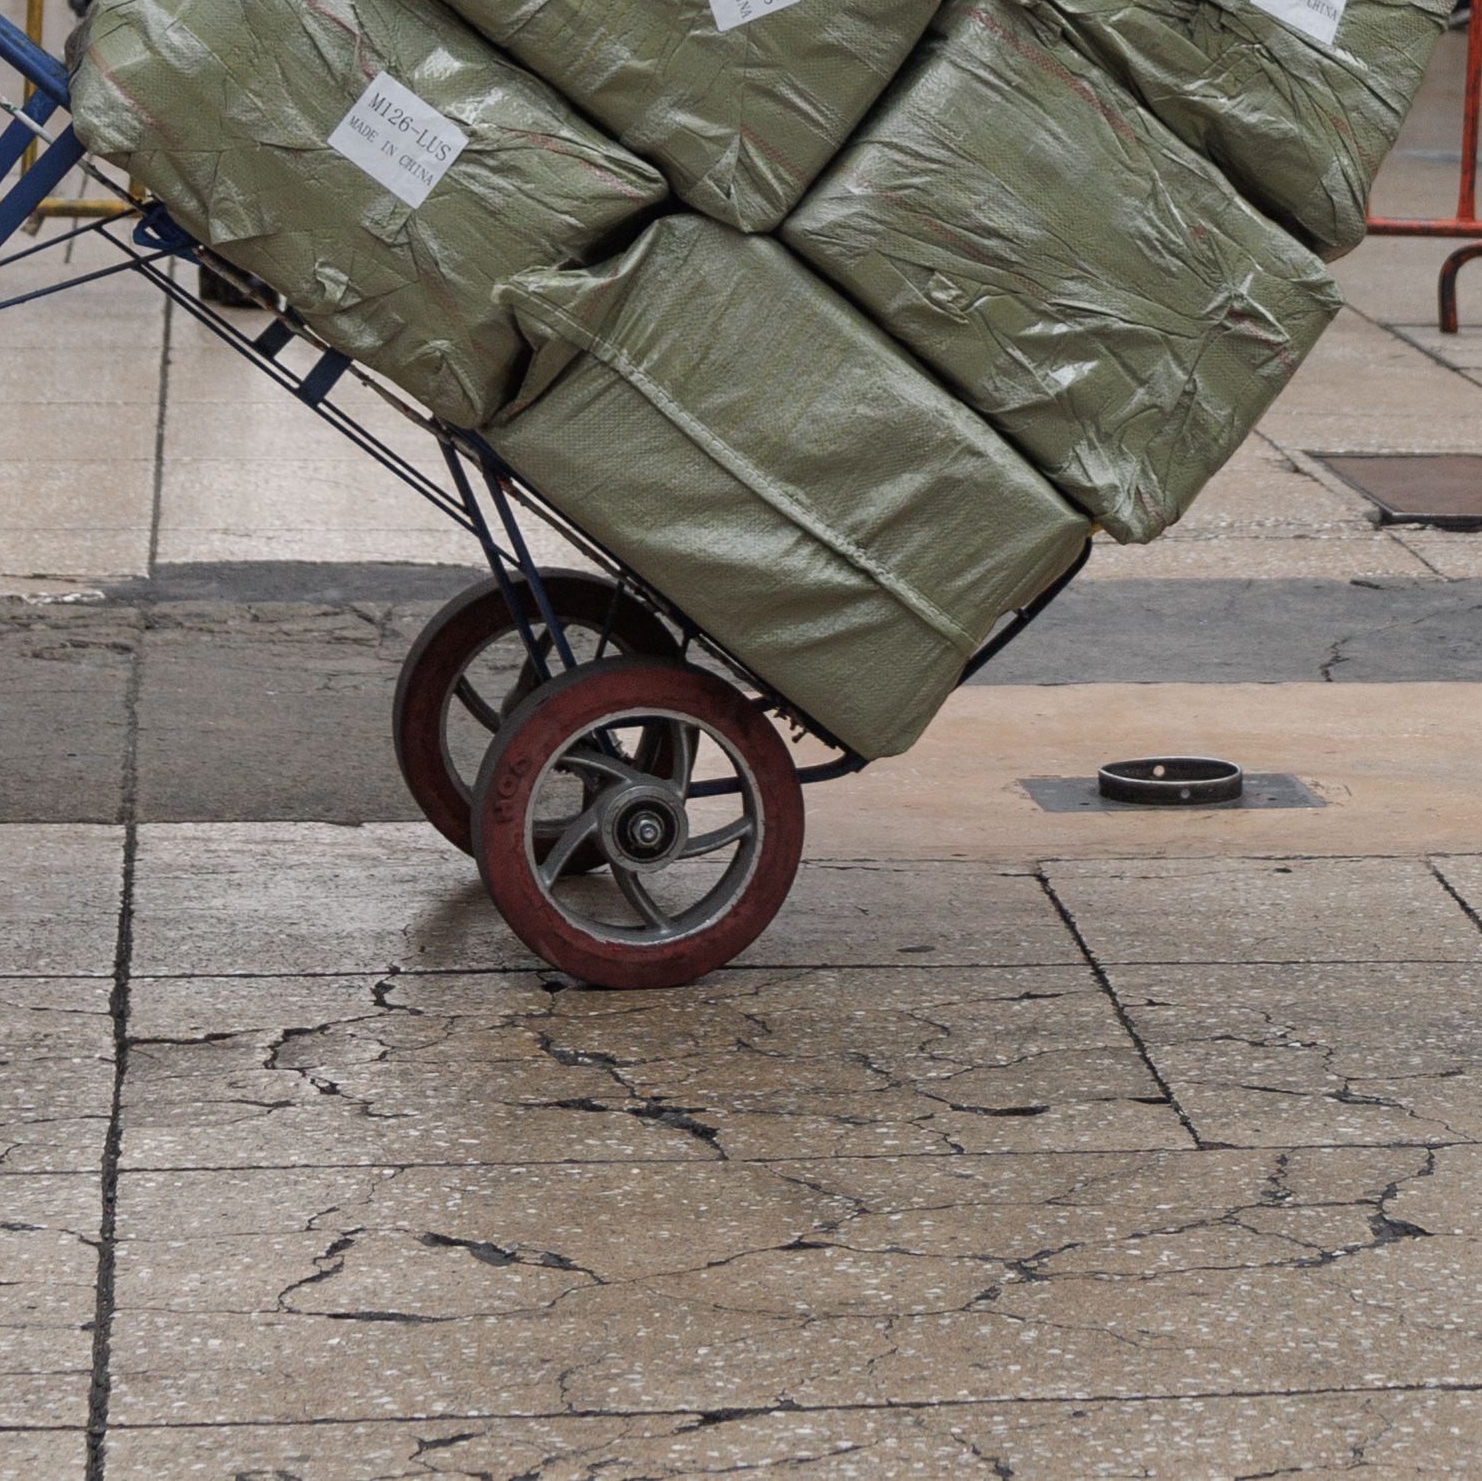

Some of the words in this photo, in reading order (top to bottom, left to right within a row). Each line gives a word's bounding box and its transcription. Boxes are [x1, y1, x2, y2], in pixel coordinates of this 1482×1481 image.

[348, 115, 379, 143] MADE
[380, 140, 399, 157] IN
[398, 154, 434, 186] CHINA
[368, 92, 452, 162] M126-LUS
